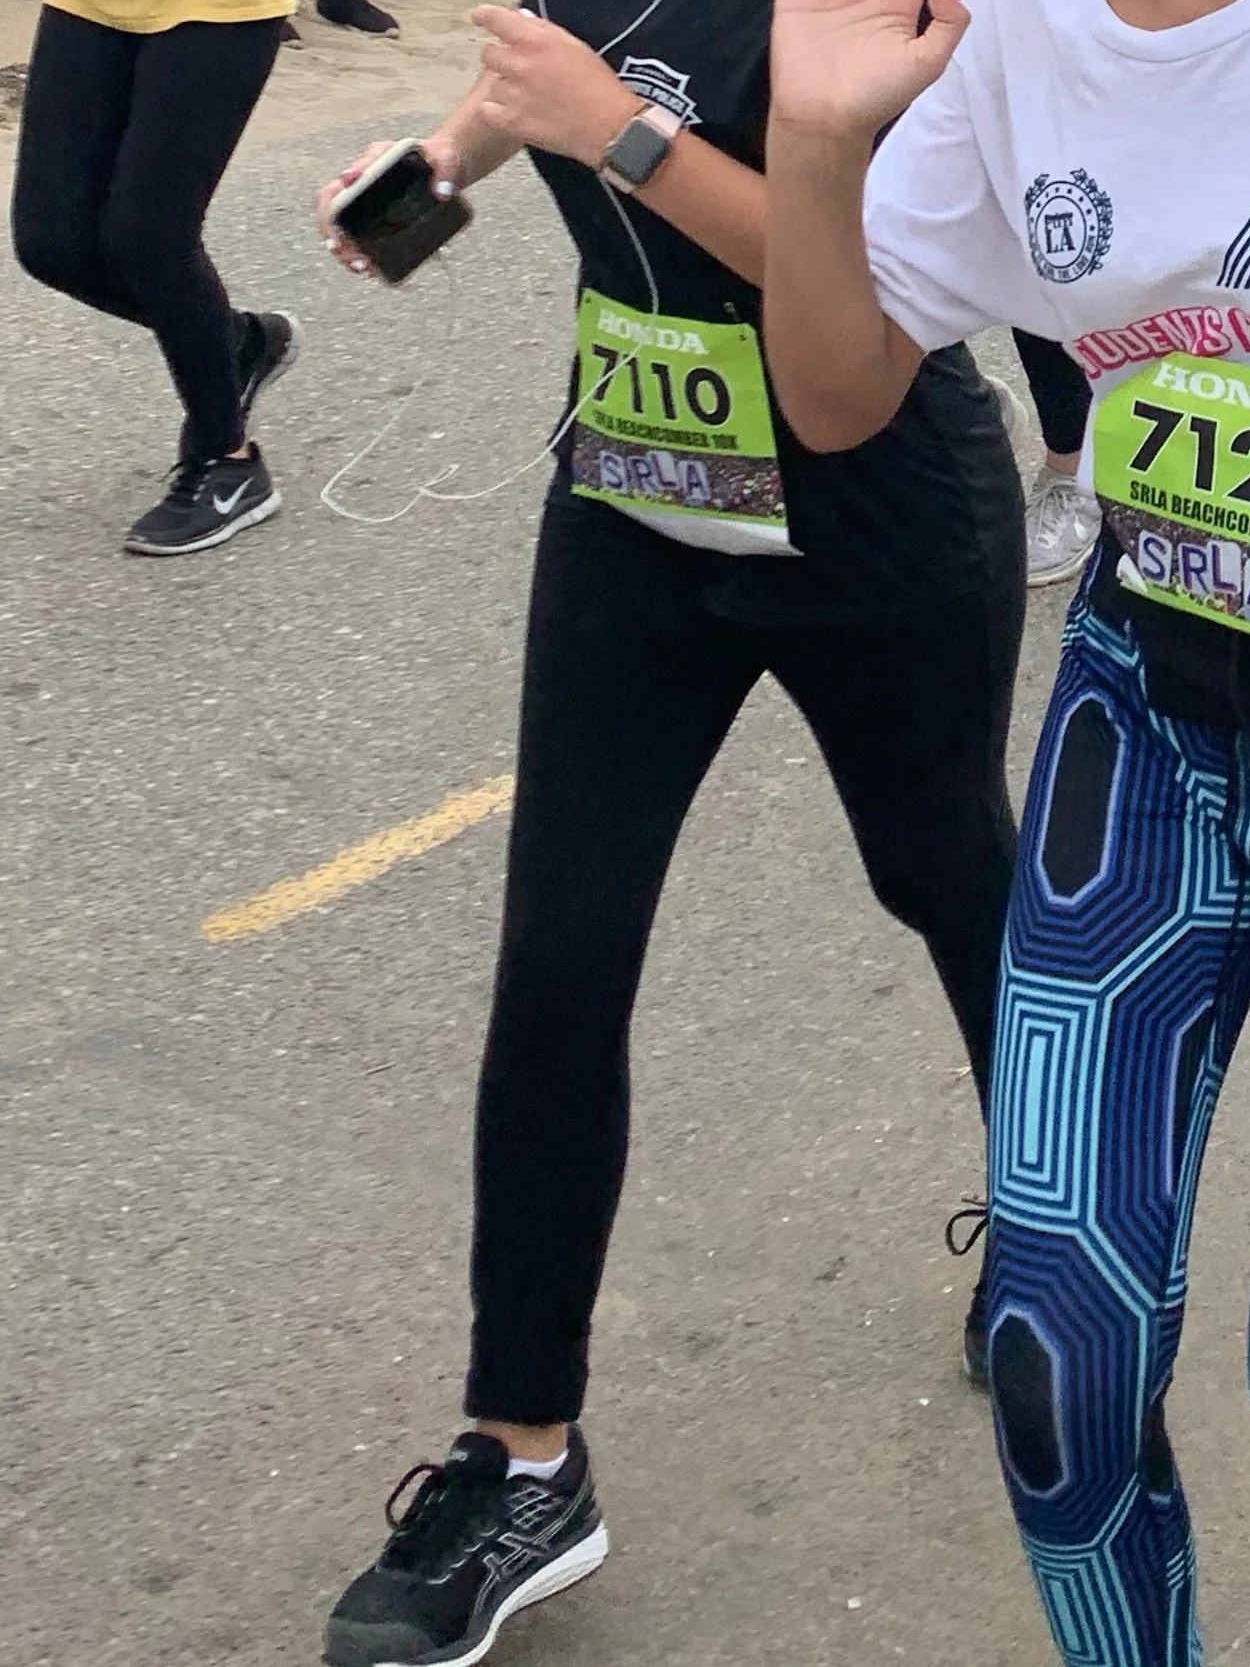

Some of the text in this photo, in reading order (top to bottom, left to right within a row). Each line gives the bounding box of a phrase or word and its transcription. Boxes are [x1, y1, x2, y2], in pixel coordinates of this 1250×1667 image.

[599, 309, 710, 355] HONDA
[1072, 305, 1233, 380] TUDENTS
[592, 343, 731, 427] 7110
[602, 453, 706, 495] SRLA
[1130, 480, 1167, 510] SRLA
